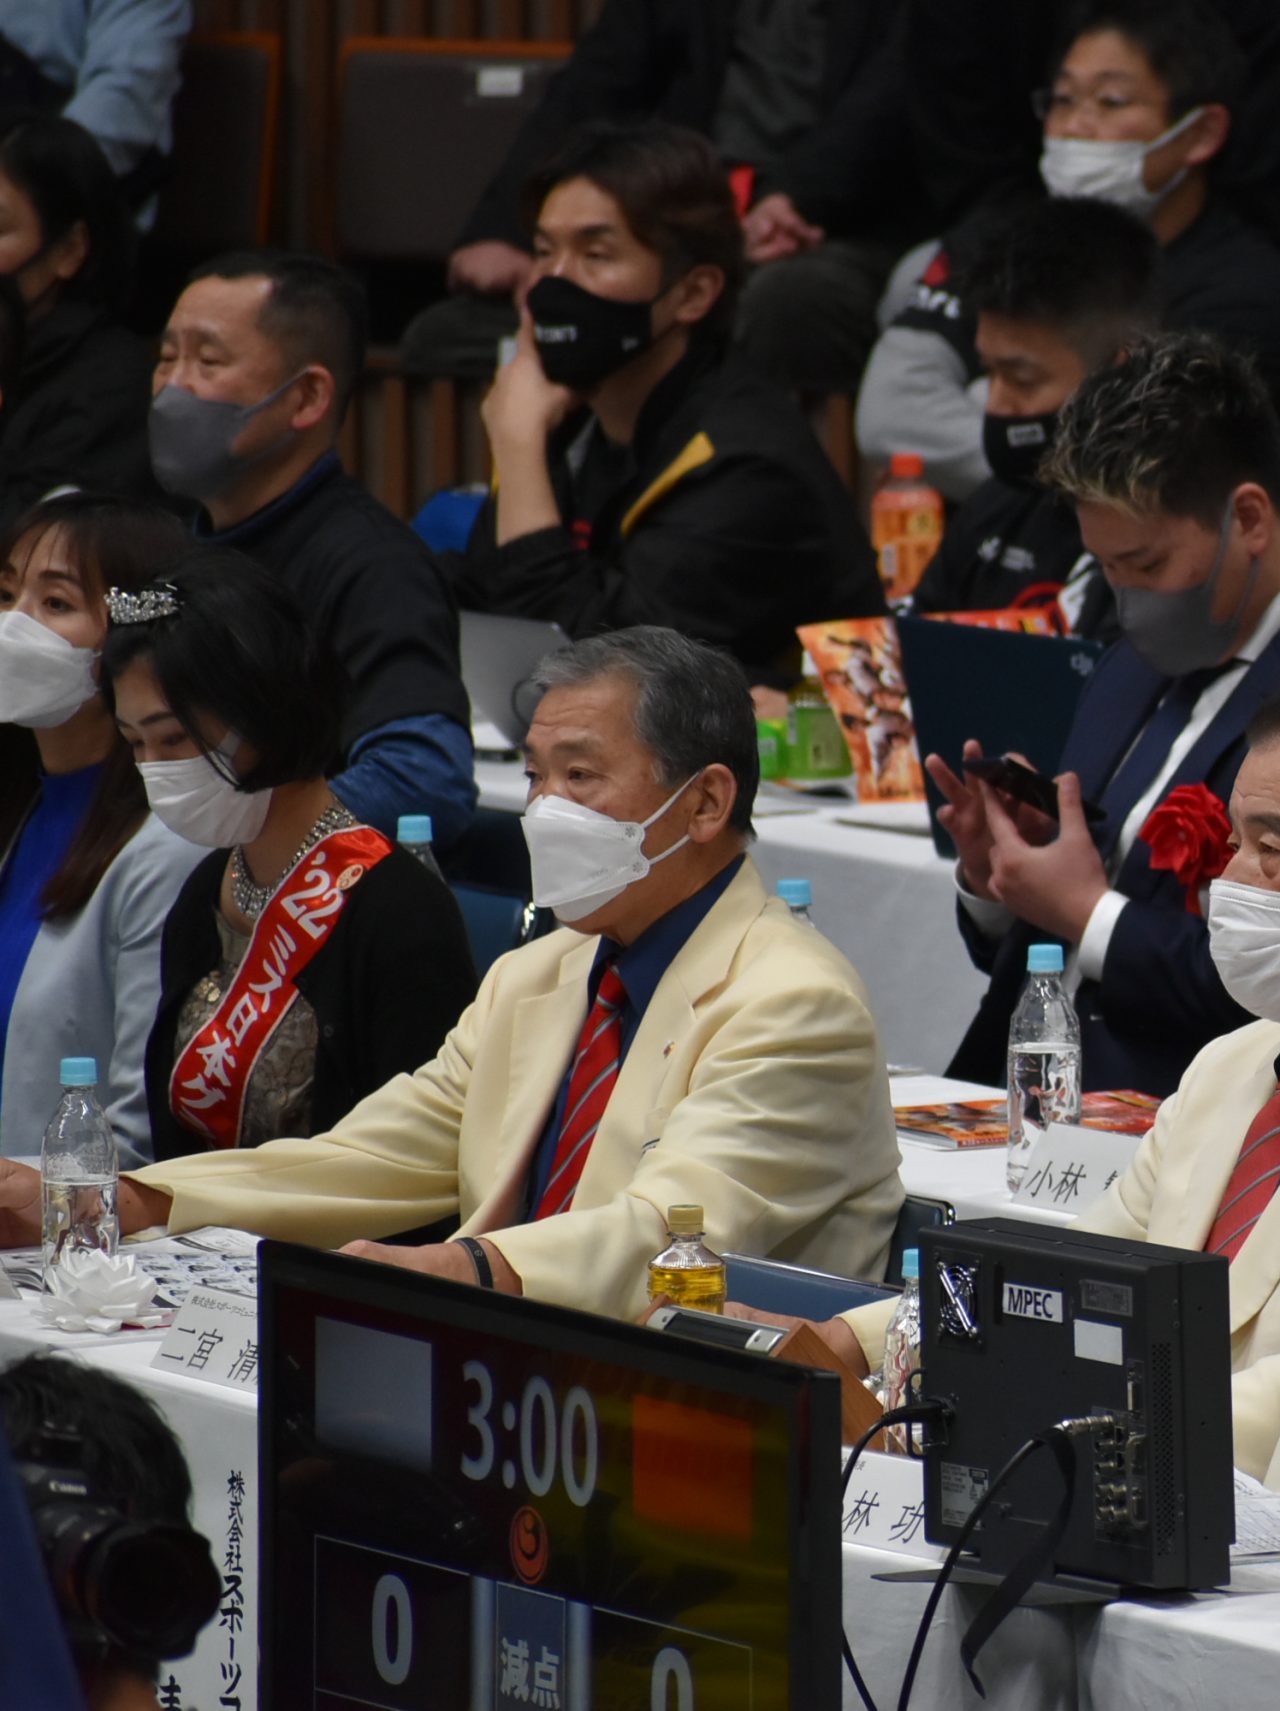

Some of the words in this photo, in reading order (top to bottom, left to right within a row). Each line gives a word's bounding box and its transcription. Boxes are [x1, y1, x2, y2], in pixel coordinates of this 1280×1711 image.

[1025, 1160, 1087, 1204] 小林
[1007, 1286, 1054, 1319] MPEC
[161, 1328, 223, 1370] 二宮
[460, 1360, 598, 1507] 3:00
[371, 1574, 412, 1685] 0
[500, 1636, 561, 1711] 減点
